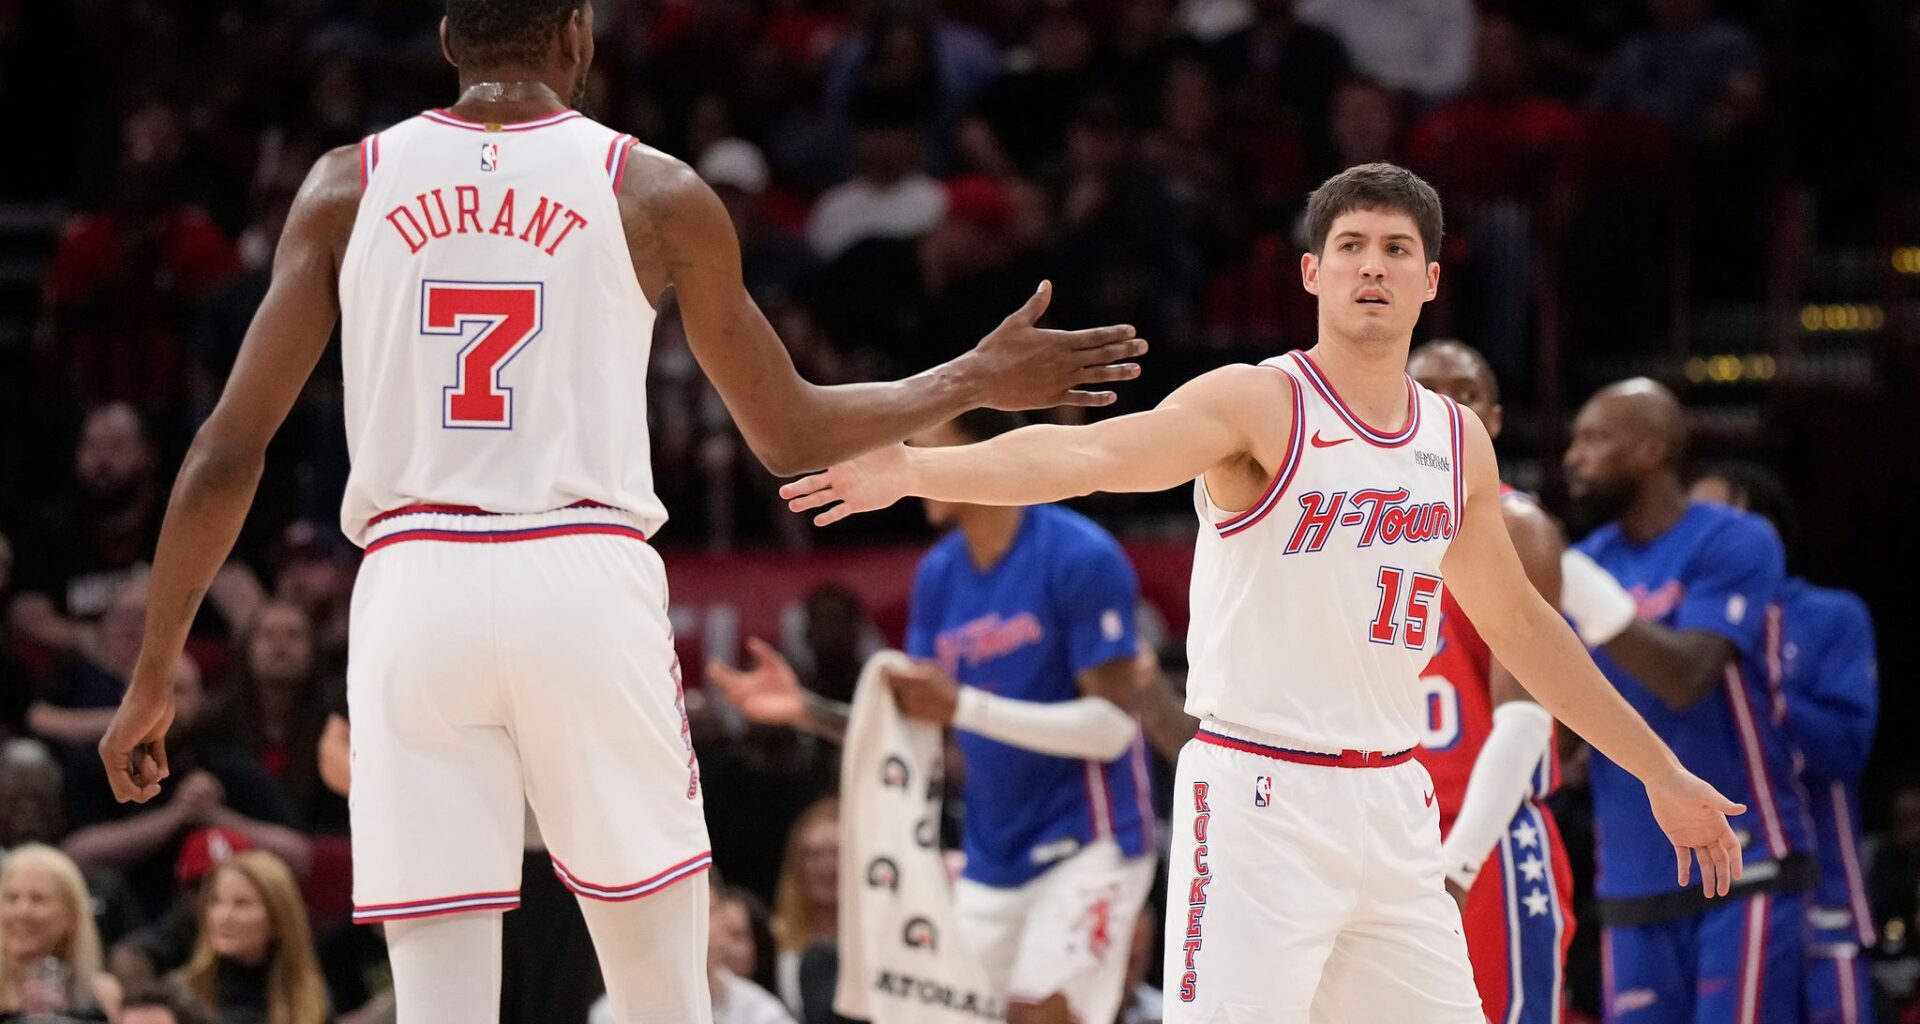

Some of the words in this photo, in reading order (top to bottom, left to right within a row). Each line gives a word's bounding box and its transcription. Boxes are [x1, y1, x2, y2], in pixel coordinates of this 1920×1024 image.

[386, 185, 588, 256] DURANT
[420, 279, 543, 430] 7
[1282, 487, 1453, 555] H-Town
[1368, 565, 1443, 650] 15
[1180, 781, 1212, 1002] ROCKETS
